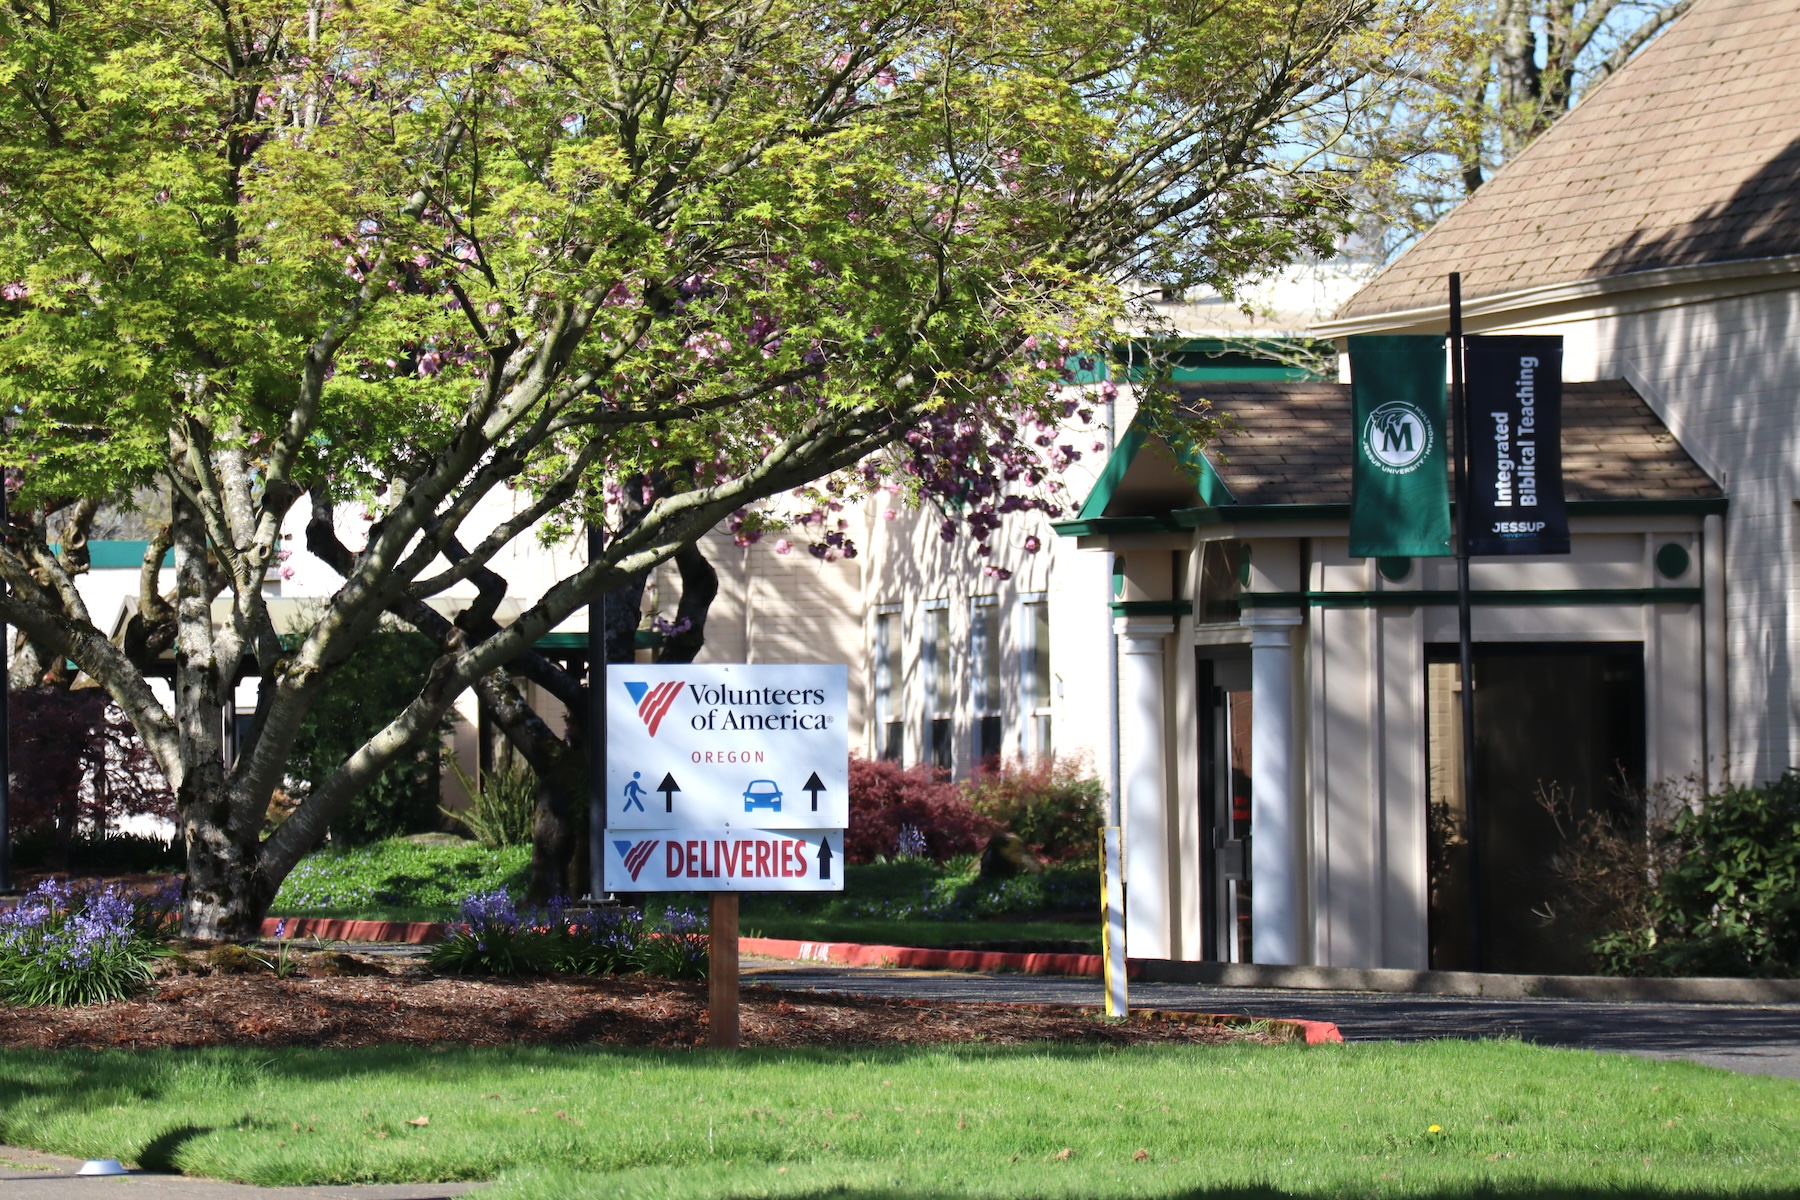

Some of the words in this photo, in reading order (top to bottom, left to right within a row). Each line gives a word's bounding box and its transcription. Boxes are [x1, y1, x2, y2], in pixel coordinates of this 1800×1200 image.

[1516, 356, 1539, 434] Teaching
[1380, 422, 1416, 452] M
[1363, 440, 1381, 467] JESSUP
[1382, 458, 1424, 475] UNIVERSITY
[1491, 412, 1514, 507] Integrated
[1517, 441, 1538, 507] Biblical
[1491, 521, 1546, 533] JESSUP
[688, 683, 825, 706] Volunteers
[691, 708, 718, 731] of
[691, 751, 764, 764] OREGON
[666, 840, 808, 879] DELIVERIES
